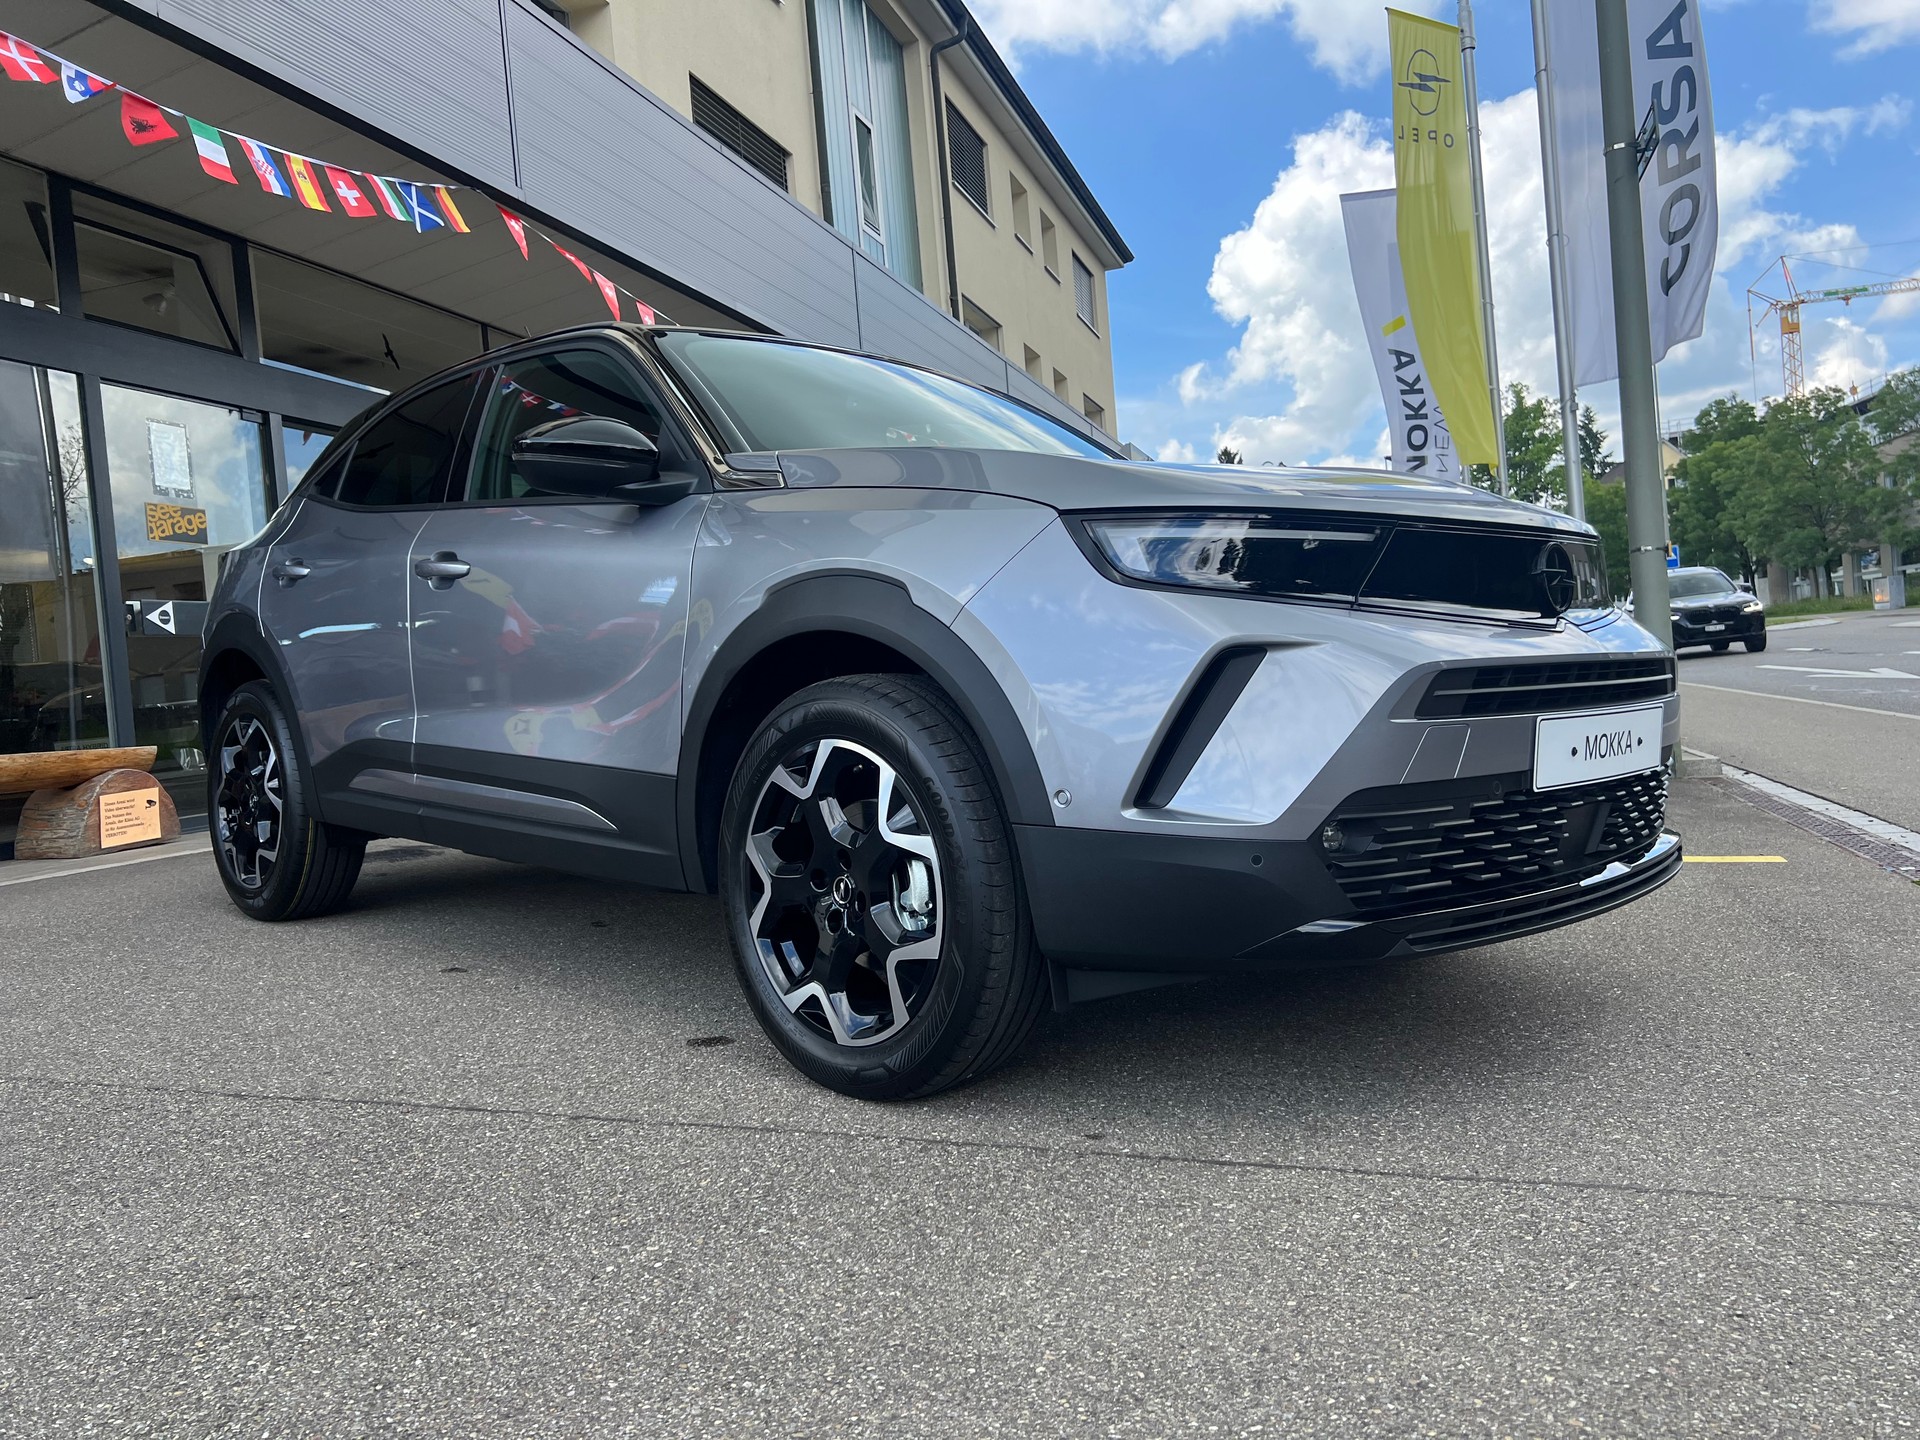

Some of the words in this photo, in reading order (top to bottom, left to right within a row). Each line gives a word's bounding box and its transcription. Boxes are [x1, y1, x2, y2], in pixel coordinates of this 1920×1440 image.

[1645, 1, 1701, 297] CORSA
[147, 502, 182, 522] see
[148, 511, 208, 541] garage
[1584, 729, 1633, 761] MOKKA
